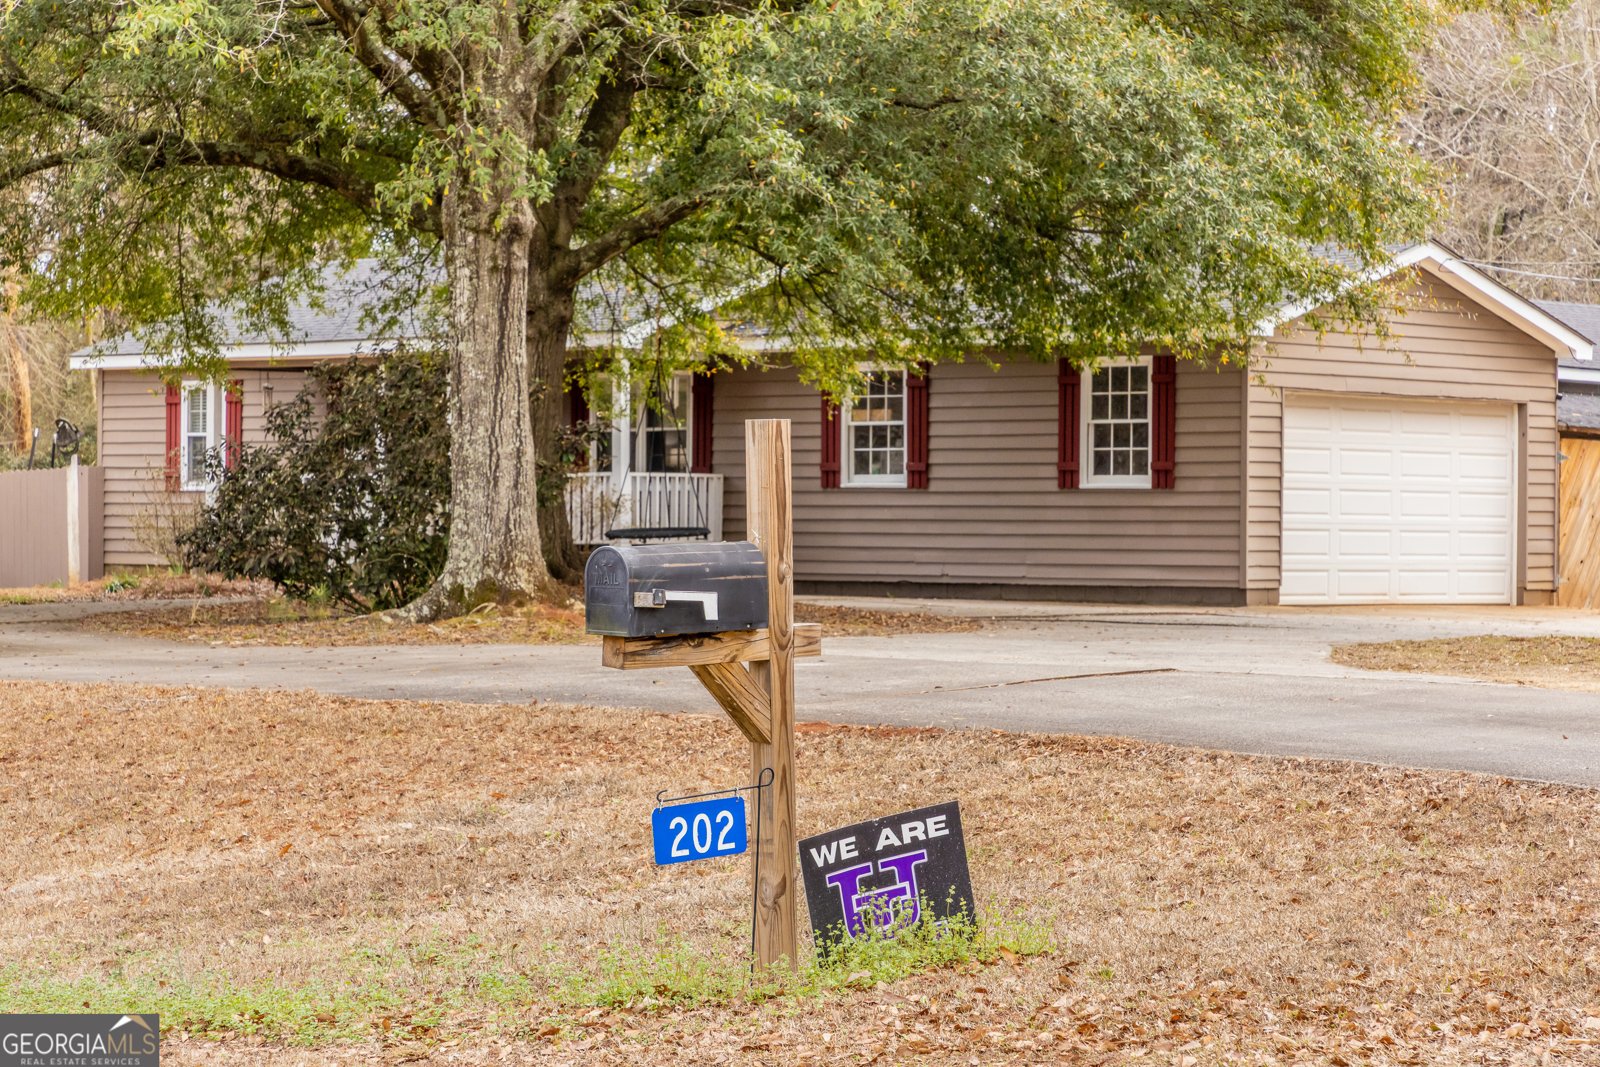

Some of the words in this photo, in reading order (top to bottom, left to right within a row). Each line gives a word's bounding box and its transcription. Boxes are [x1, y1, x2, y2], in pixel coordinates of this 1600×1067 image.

[593, 571, 619, 585] MAIL
[668, 810, 736, 858] 202
[809, 836, 859, 868] WE
[875, 814, 950, 851] ARE
